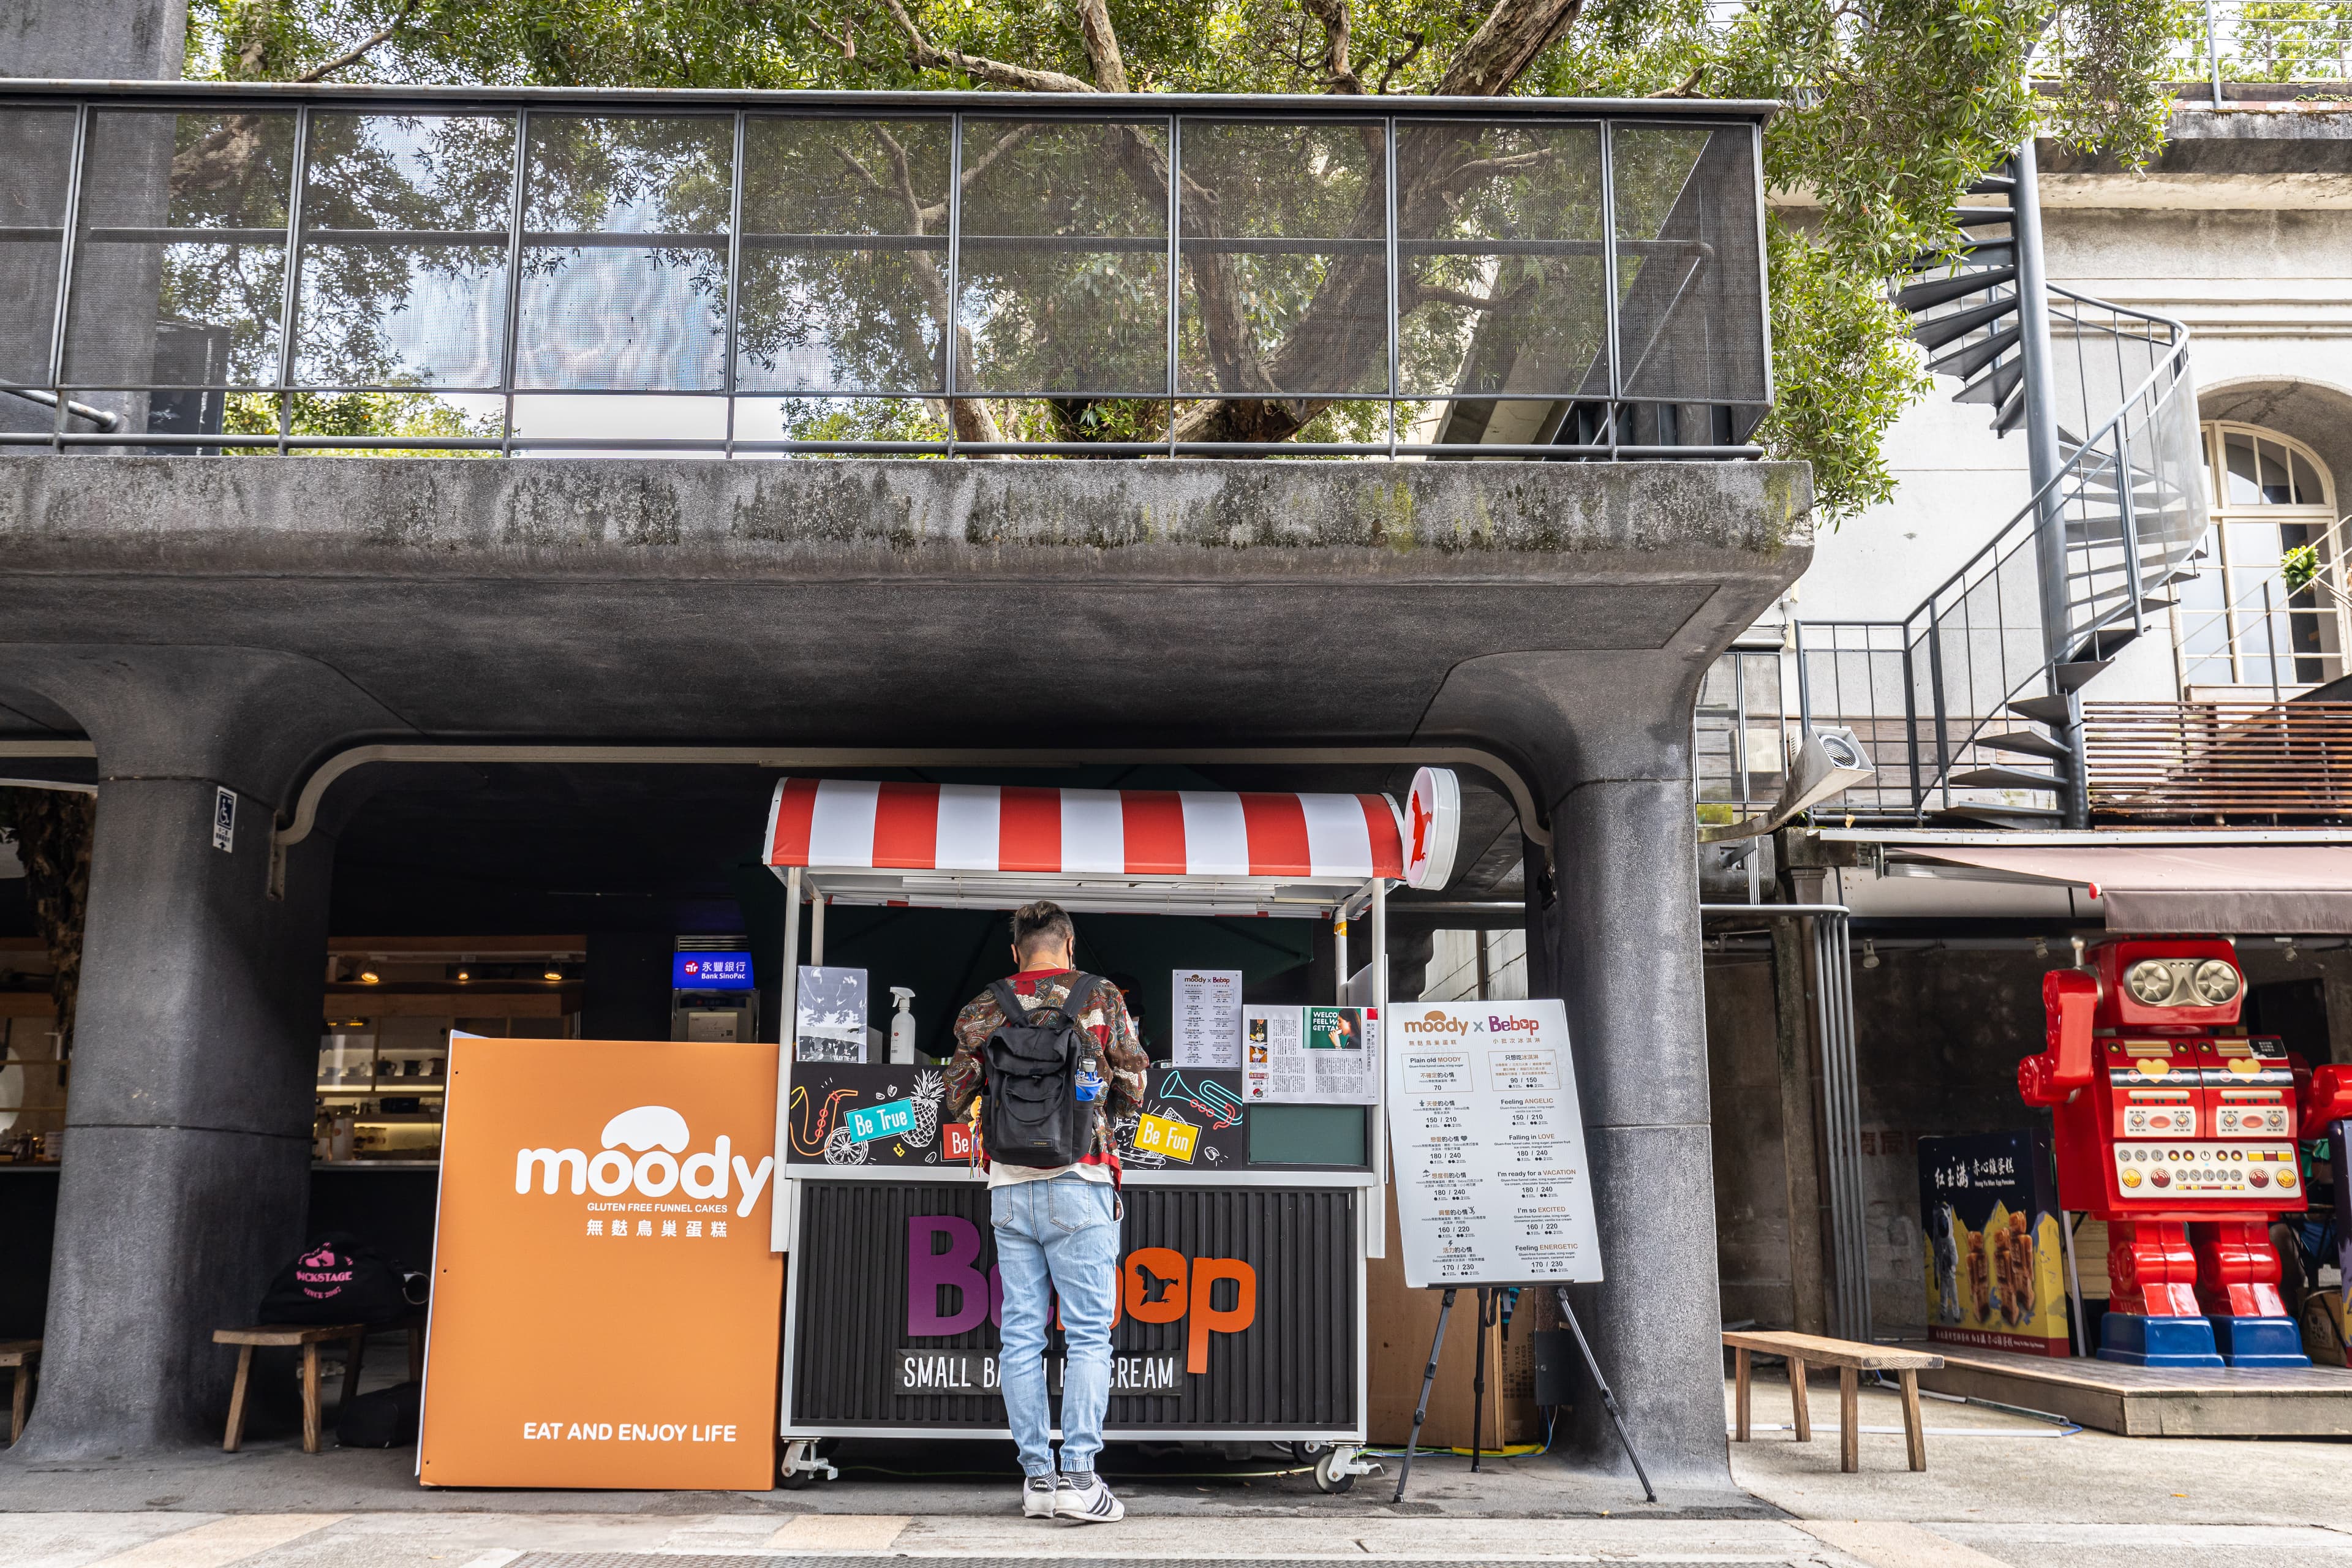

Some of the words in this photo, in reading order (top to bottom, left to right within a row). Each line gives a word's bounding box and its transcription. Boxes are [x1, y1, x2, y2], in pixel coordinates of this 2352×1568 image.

[702, 962, 746, 972] 永豐銀行
[1404, 1017, 1469, 1036] moody
[1488, 1015, 1539, 1036] Bebop
[854, 1114, 873, 1137] Be
[876, 1109, 908, 1131] True
[952, 1132, 969, 1155] Be
[1142, 1121, 1161, 1145] Be
[1166, 1126, 1189, 1152] Fun
[514, 1134, 774, 1218] moody
[587, 1202, 625, 1212] GLUTEN
[627, 1203, 652, 1212] FREE
[654, 1204, 693, 1213] FUNNEL
[695, 1204, 728, 1213] CAKES
[586, 1219, 727, 1238] 無麩鳥巢蛋糕
[907, 1215, 1256, 1374] Bop
[903, 1356, 971, 1388] SMALL
[523, 1422, 564, 1440] EAT
[567, 1422, 612, 1441] AND
[618, 1423, 688, 1442] ENJOY
[692, 1424, 737, 1442] LIFE
